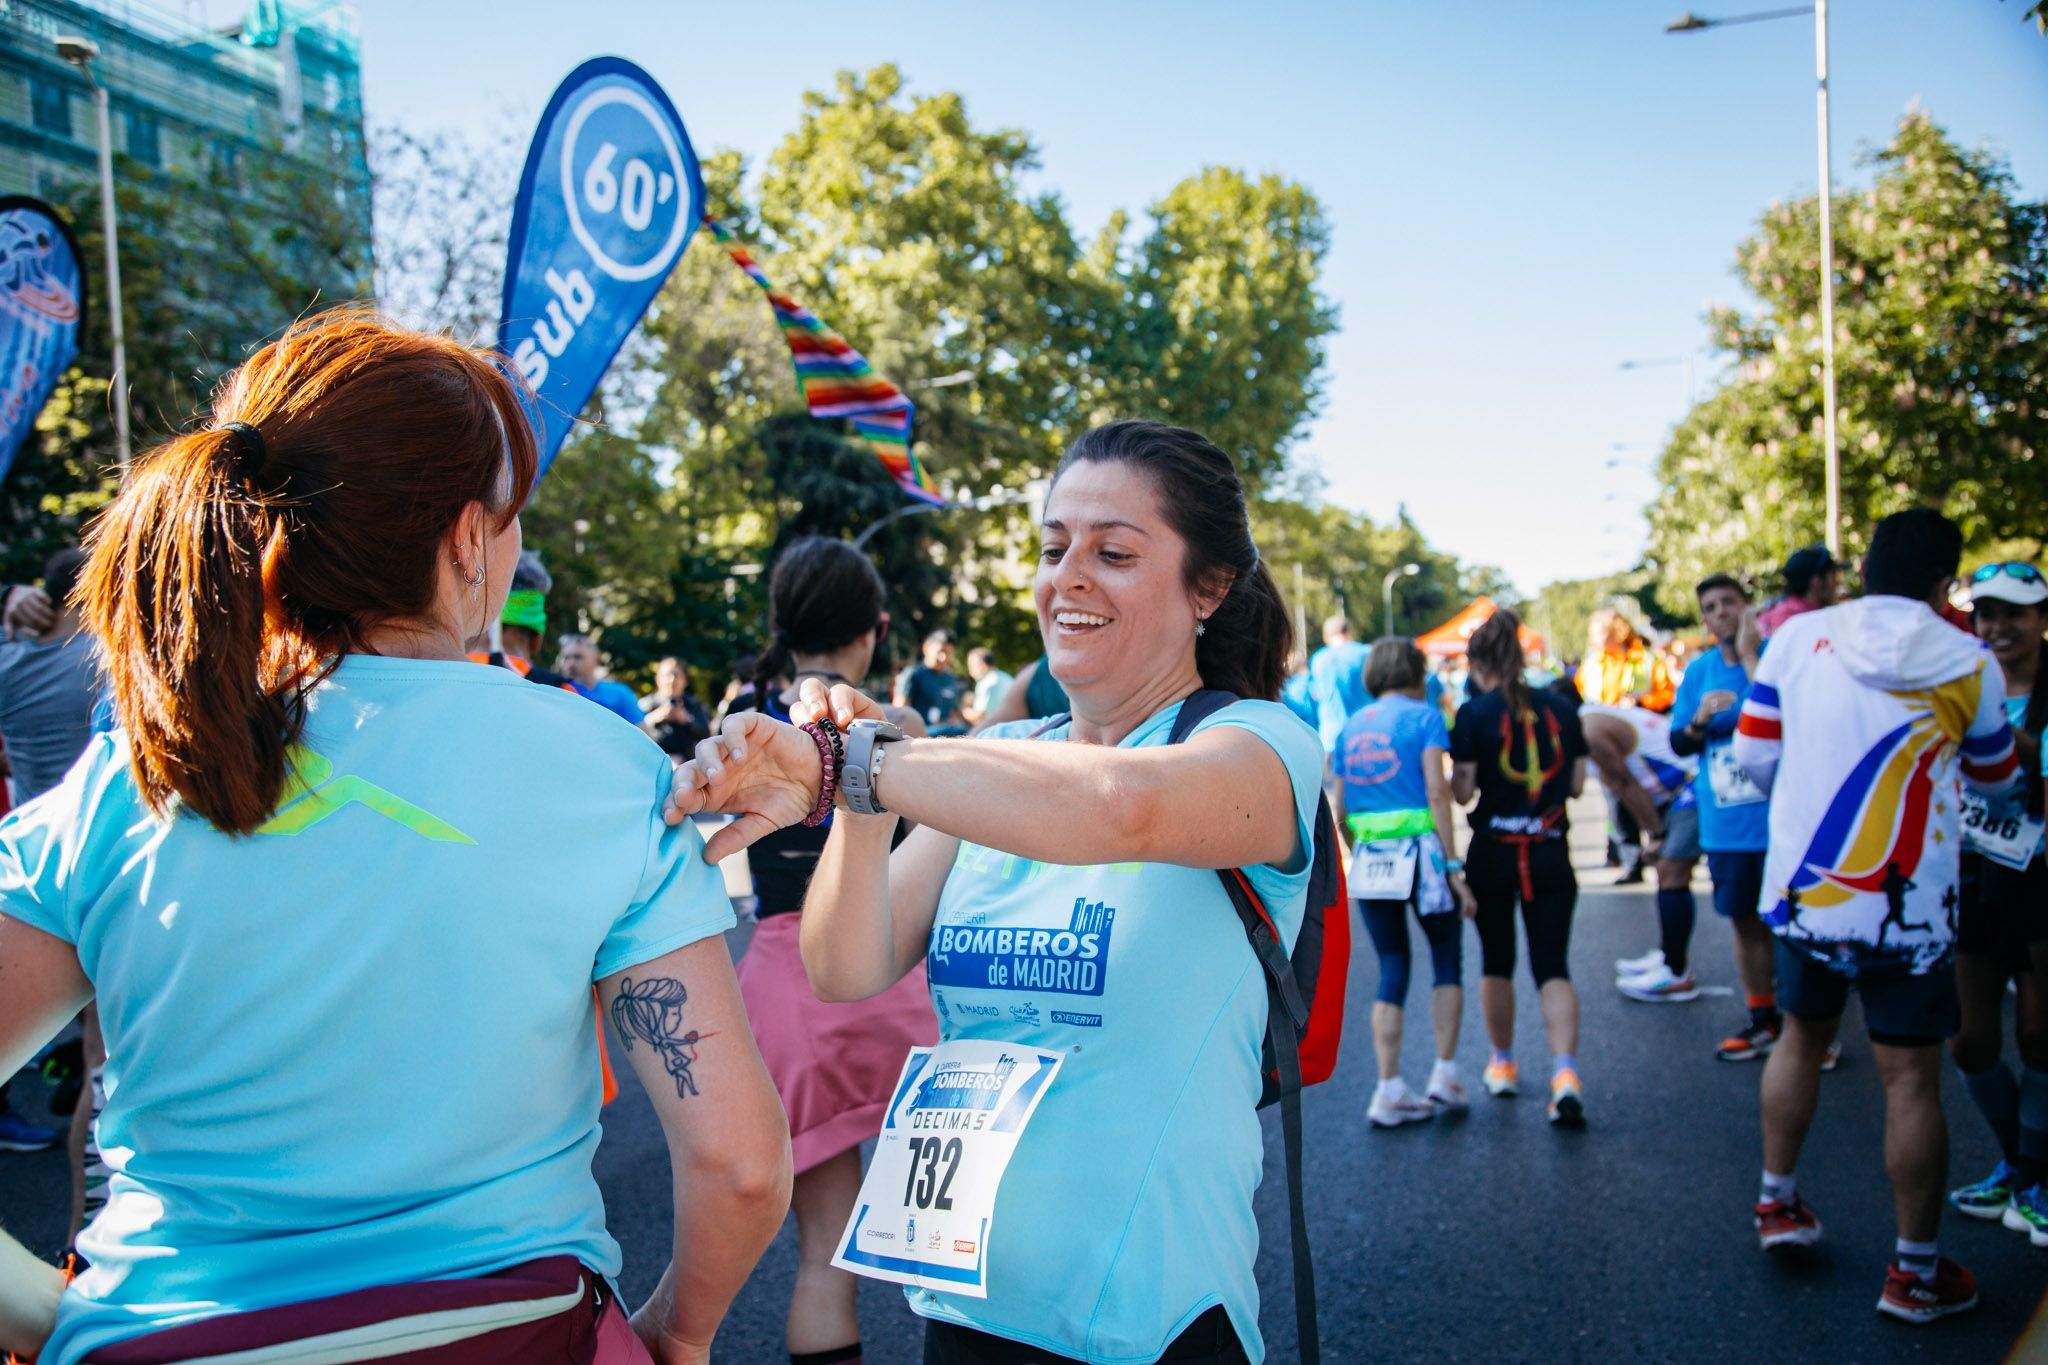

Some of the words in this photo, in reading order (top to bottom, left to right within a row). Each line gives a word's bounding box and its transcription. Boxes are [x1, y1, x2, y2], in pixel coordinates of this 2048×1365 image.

[512, 266, 596, 391] sub
[940, 928, 1101, 960] BOMBEROS
[988, 957, 1009, 986] de
[1013, 959, 1098, 992] MADRID
[964, 1004, 1000, 1017] MADRID
[932, 1072, 1005, 1091] BOMBEROS
[913, 1111, 988, 1131] DECIMAS
[903, 1136, 964, 1212] 732
